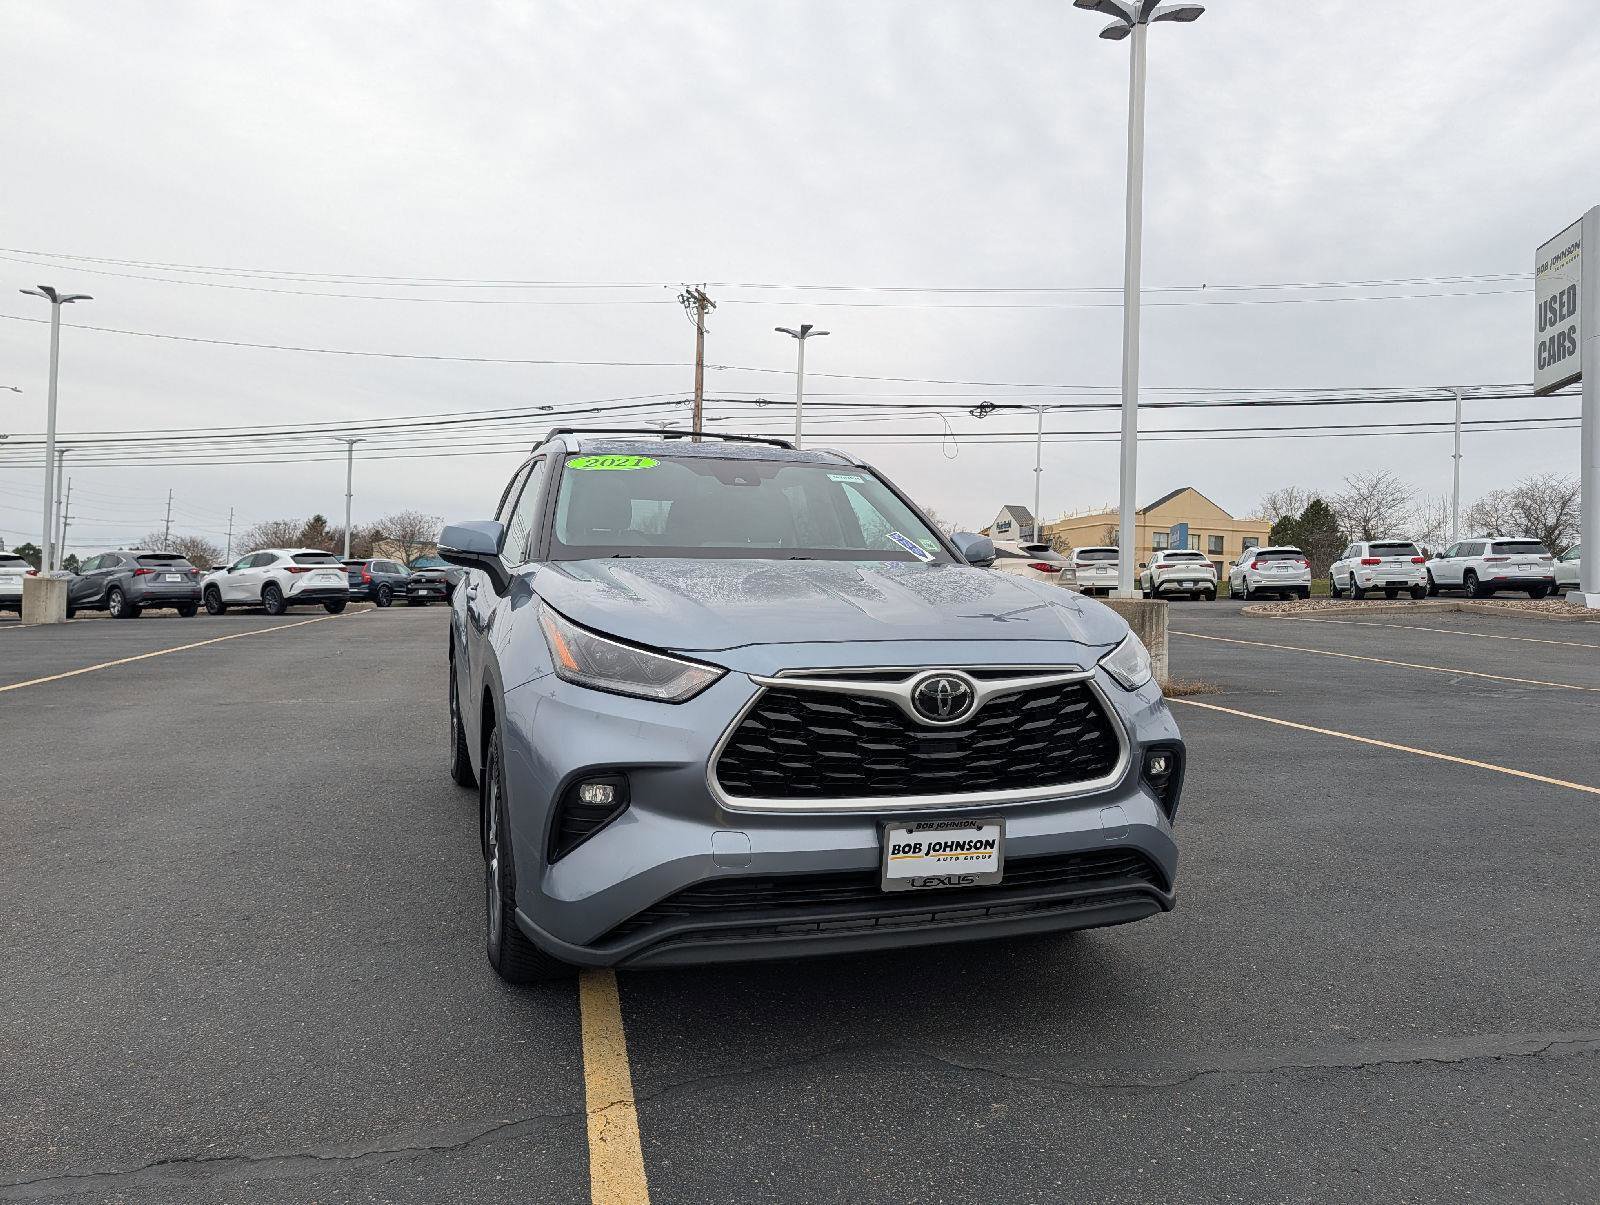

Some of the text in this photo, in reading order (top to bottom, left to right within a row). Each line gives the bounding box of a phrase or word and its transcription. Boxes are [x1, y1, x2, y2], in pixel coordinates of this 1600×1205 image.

[1537, 261, 1548, 276] BOB
[1550, 239, 1581, 270] JOHNSON
[1538, 283, 1577, 333] USED
[1537, 324, 1577, 370] CARS
[583, 458, 643, 467] 2021
[915, 820, 977, 830] BOB JOHNSON
[891, 839, 997, 856] BOB JOHNSON
[911, 875, 975, 888] LEXUS
